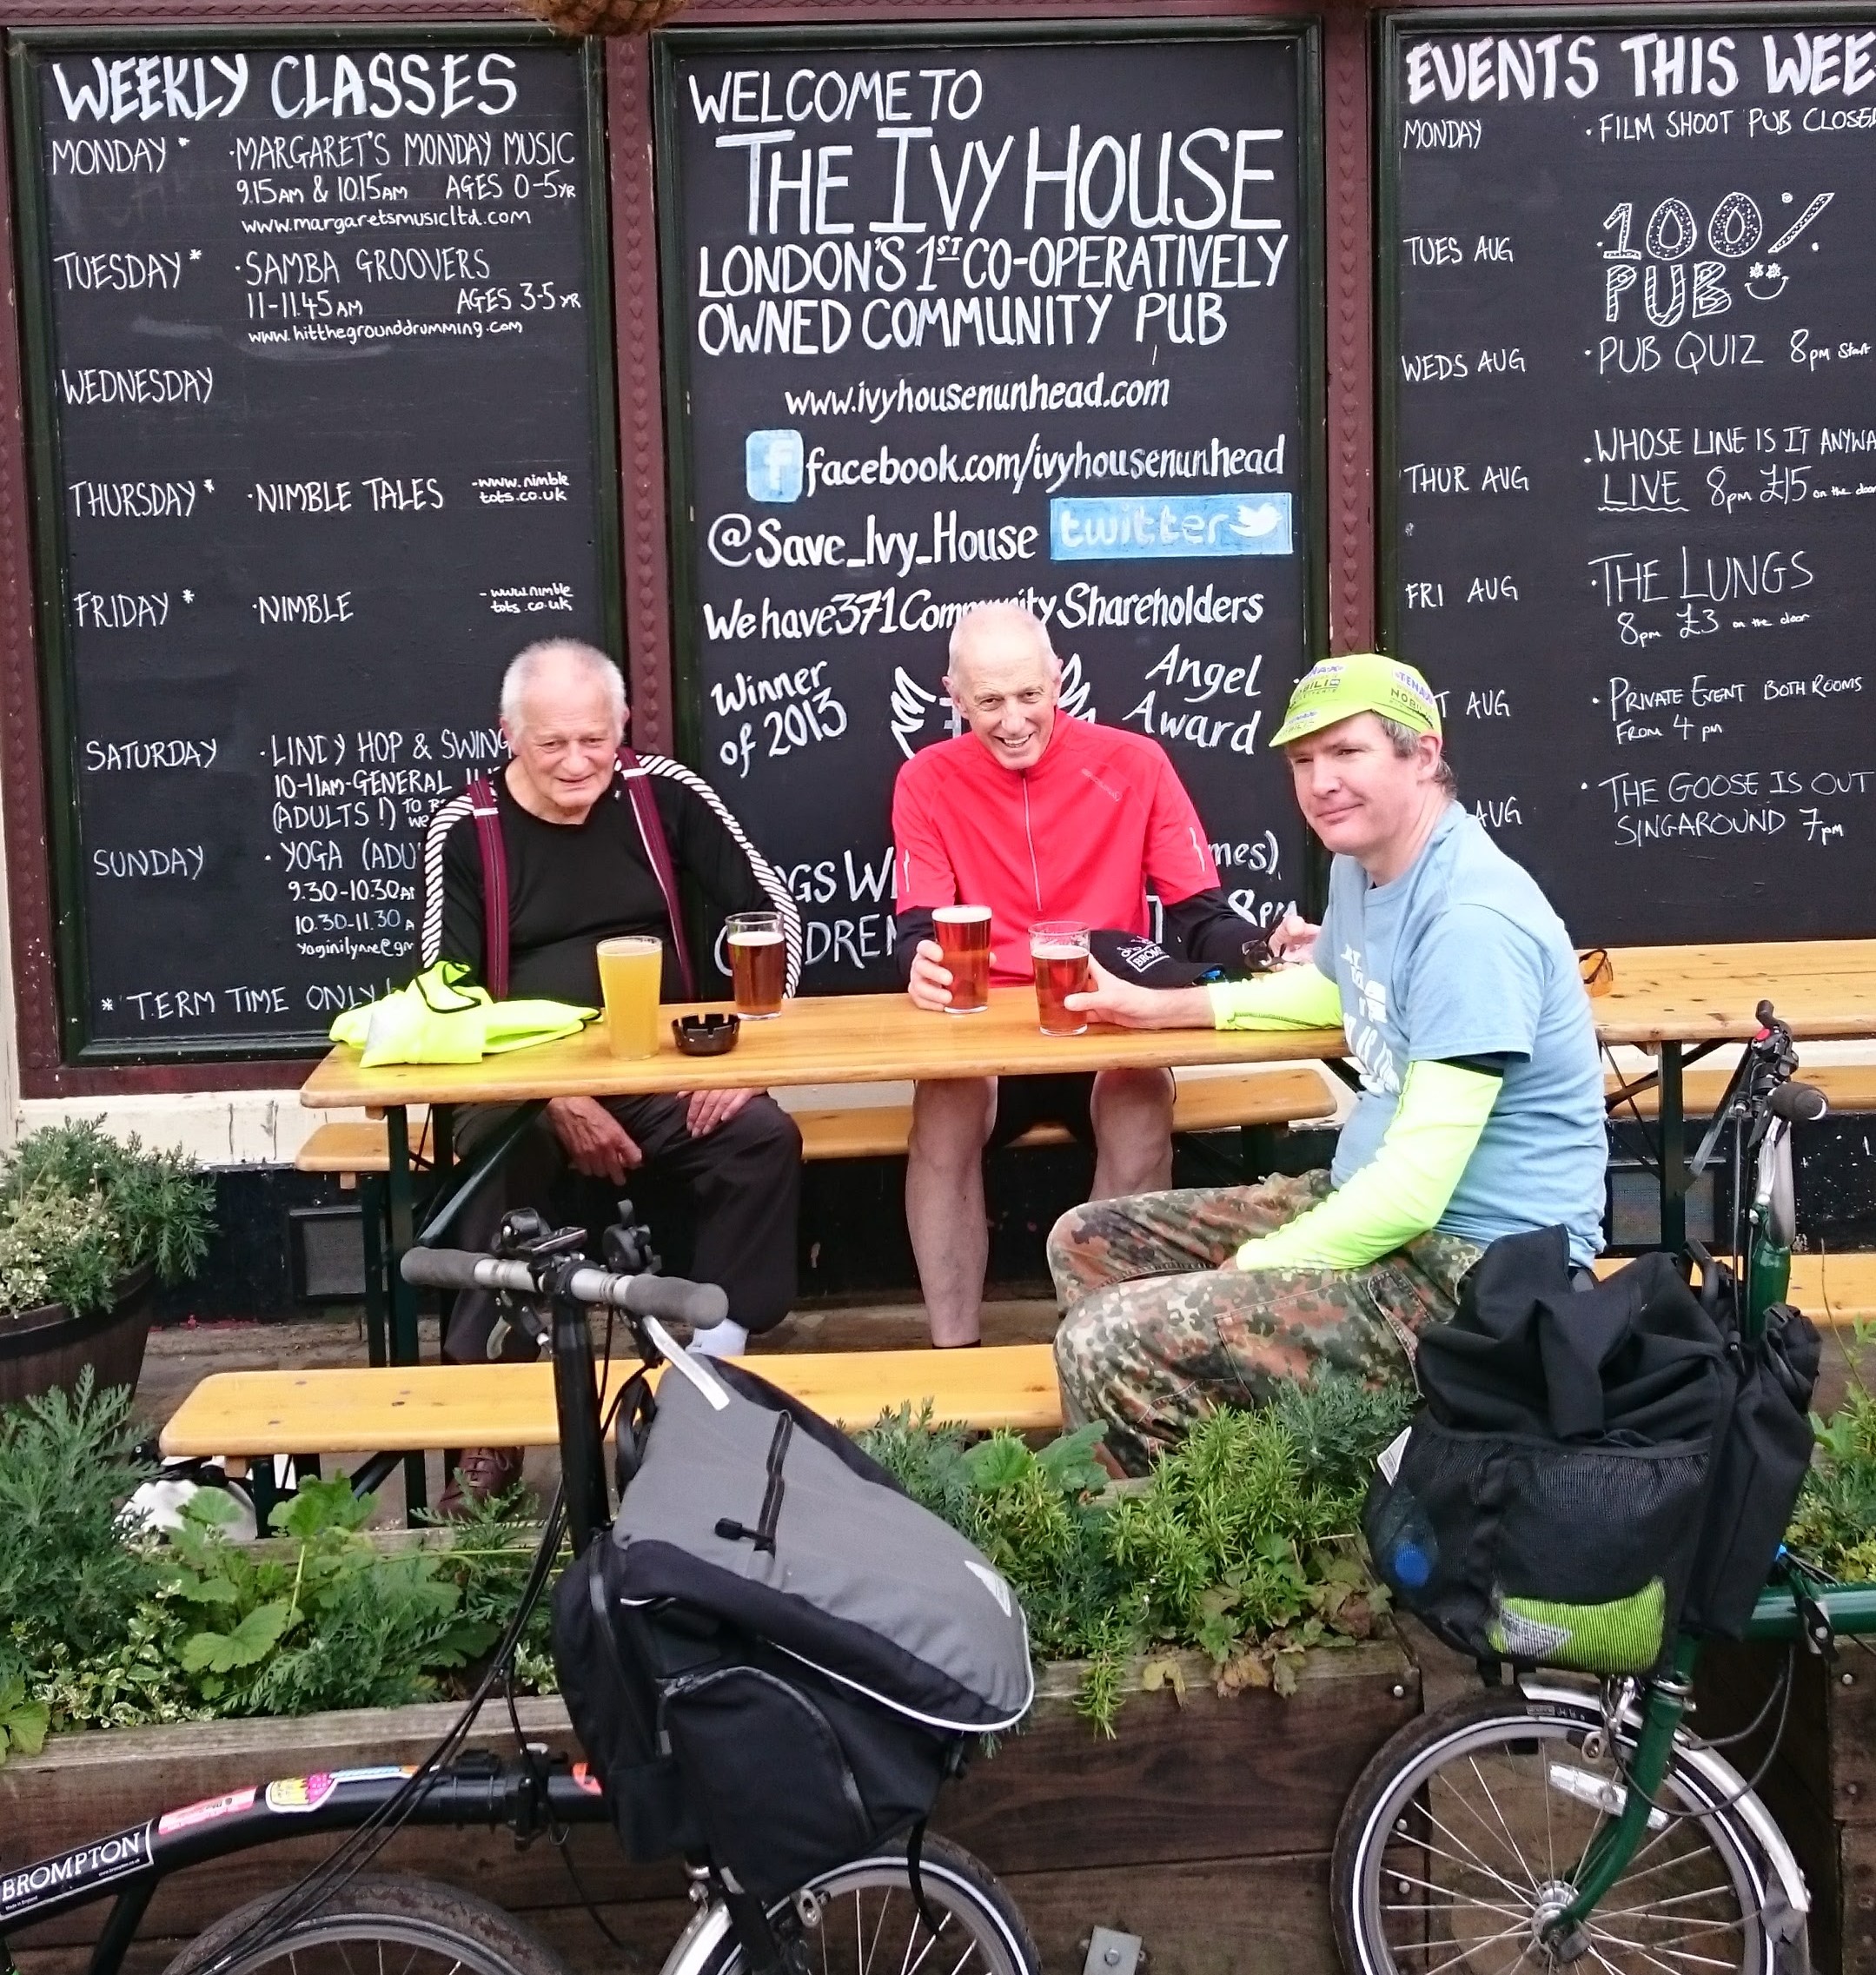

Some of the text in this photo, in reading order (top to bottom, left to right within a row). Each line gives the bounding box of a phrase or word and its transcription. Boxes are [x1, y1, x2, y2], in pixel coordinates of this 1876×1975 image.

[1405, 30, 1876, 105] EVENTS THIS WEE
[52, 51, 518, 124] WEEKLY CLASSES
[688, 68, 983, 124] WELCOME TO
[1402, 118, 1482, 149] MONDAY
[1599, 112, 1655, 144] FILM
[1665, 109, 1734, 138] SHOOT
[1747, 107, 1793, 138] PUB
[52, 136, 167, 176] MONDAY
[235, 129, 575, 171] MARGARET'S MONDAY MUSIC
[312, 174, 329, 203] &
[445, 173, 504, 201] AGES
[714, 123, 1284, 236] THE IVY HOUSE
[241, 204, 532, 235] www.margaretsmusicltd.com
[1602, 190, 1835, 261] 100%
[245, 246, 490, 287] SAMBA GROOVERS
[698, 235, 907, 299] LONDON'S
[962, 233, 1289, 293] CO-OPERATIVELY
[1402, 235, 1514, 266] TUES AUG
[53, 251, 181, 291] TUESDAY
[456, 287, 512, 315] AGES
[1604, 261, 1733, 328] PUB
[248, 319, 523, 346] www.hitthegrounddrumming.com
[698, 291, 1228, 356] OWNED COMMUNITY PUB
[1401, 348, 1526, 382] WEDS AUG
[1599, 335, 1661, 375] PUB
[1674, 330, 1765, 375] QUIZ
[61, 367, 213, 405] WEDNESDAY
[784, 371, 1170, 424] www.ivyhousenunhead.com
[1594, 426, 1876, 463] WHOSE LINE IS IT ANYWA
[805, 432, 1286, 498] facebook.com/ivyhousenunhead
[1403, 462, 1529, 494] THUR AUG
[68, 480, 196, 518] THURSDAY
[255, 476, 444, 514] NIMBLE TALES
[479, 486, 567, 504] tots.co.uk
[1603, 469, 1680, 507] LIVE
[1760, 463, 1813, 505] £15
[706, 504, 1230, 579] @Save_Ivy_House twitter
[1404, 575, 1519, 609] FRI AUG
[1588, 546, 1813, 607] THE LUNGS
[73, 591, 169, 628] FRIDAY
[258, 591, 355, 625] NIMBLE
[702, 598, 758, 640] We
[761, 597, 838, 640] have
[830, 586, 899, 636] 371
[1056, 581, 1264, 630] Shareholders
[1675, 602, 1720, 639] £3
[711, 643, 1263, 717] Winner Angel
[1763, 679, 1806, 701] BOTH
[1812, 673, 1863, 699] ROOMS
[1465, 689, 1511, 719] AUG
[357, 731, 403, 764] HOP
[412, 732, 433, 760] &
[441, 729, 512, 759] SWING
[719, 732, 758, 779] of
[763, 686, 848, 756] 2013
[1122, 693, 1264, 756] Award
[86, 738, 217, 772] SATURDAY
[401, 797, 422, 814] TO
[1597, 770, 1875, 813] THE GOOSE IS OUT
[1475, 796, 1523, 828] AUG
[1614, 808, 1786, 847] SINGAROUND
[93, 845, 204, 881] SUNDAY
[280, 837, 421, 872] YOGA (ADU
[1132, 945, 1165, 966] BROM
[224, 985, 289, 1014] TIME
[2, 1832, 140, 1902] BROMPTON
